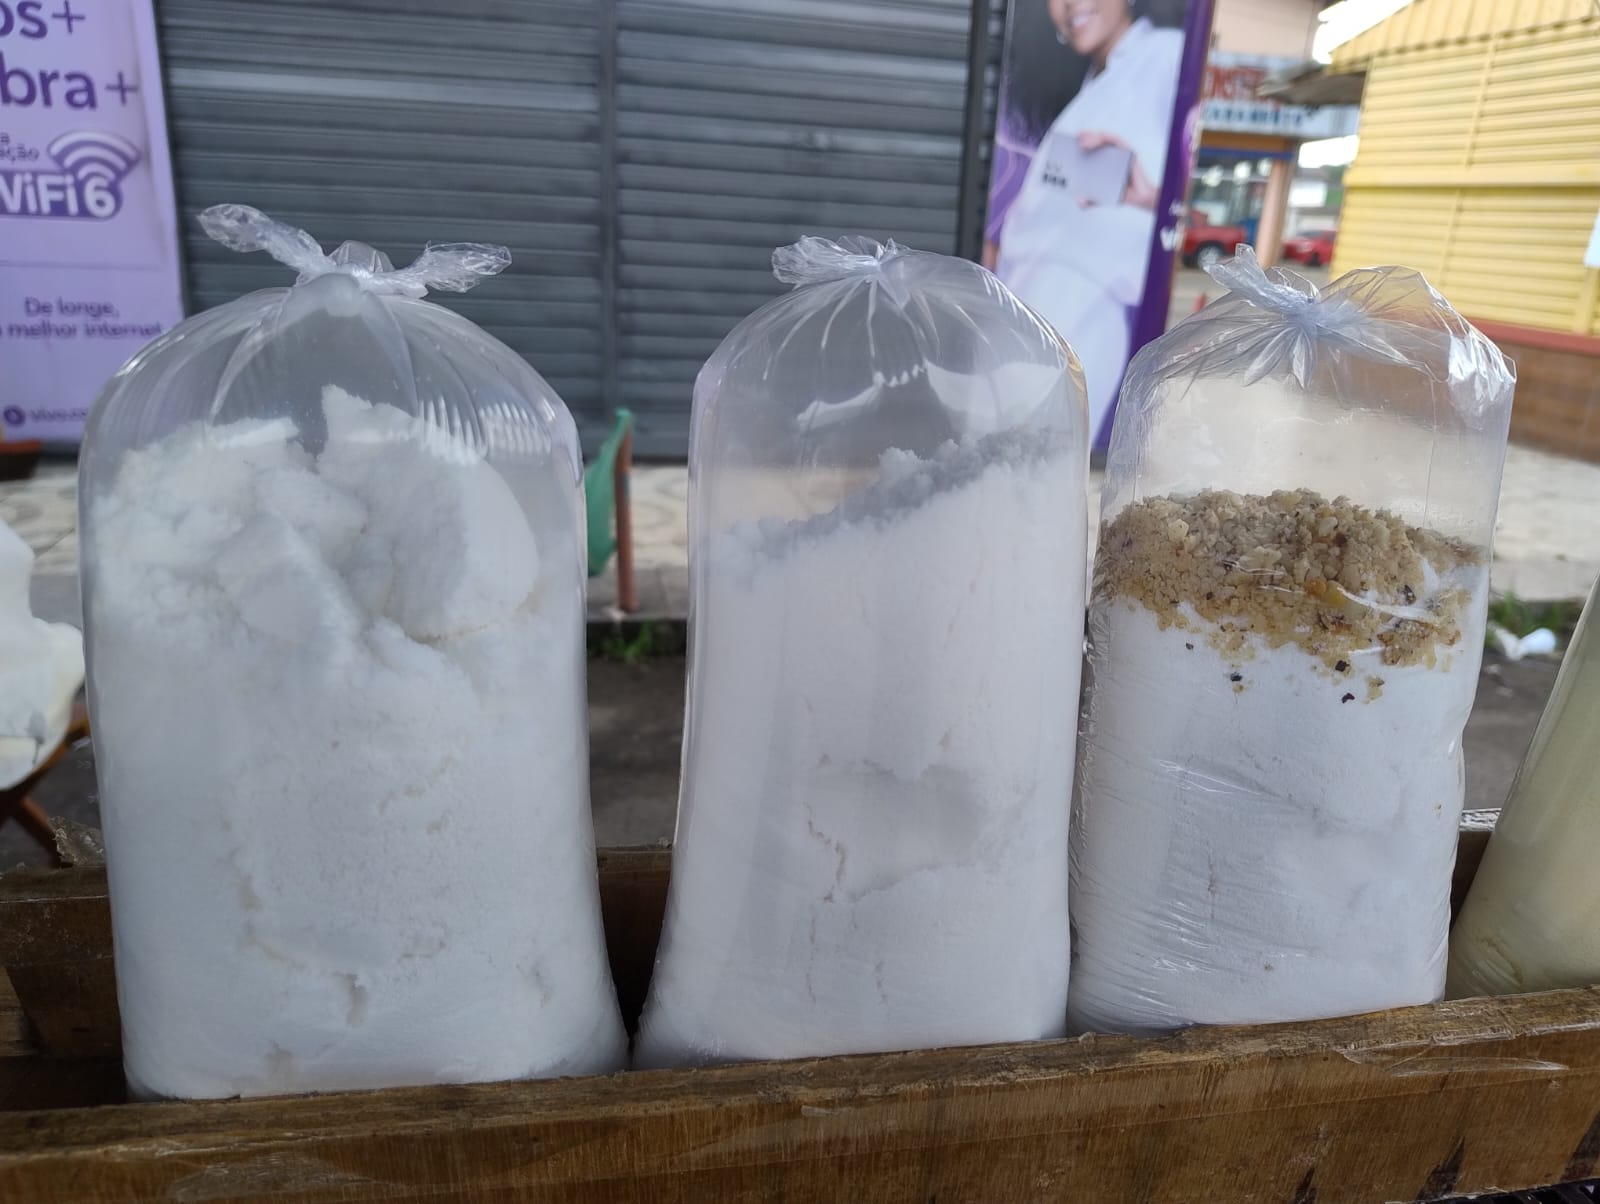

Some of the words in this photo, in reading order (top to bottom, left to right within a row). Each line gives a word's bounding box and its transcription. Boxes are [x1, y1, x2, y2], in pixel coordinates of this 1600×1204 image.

[24, 297, 52, 317] De
[8, 322, 77, 338] melhor
[84, 322, 162, 338] internet
